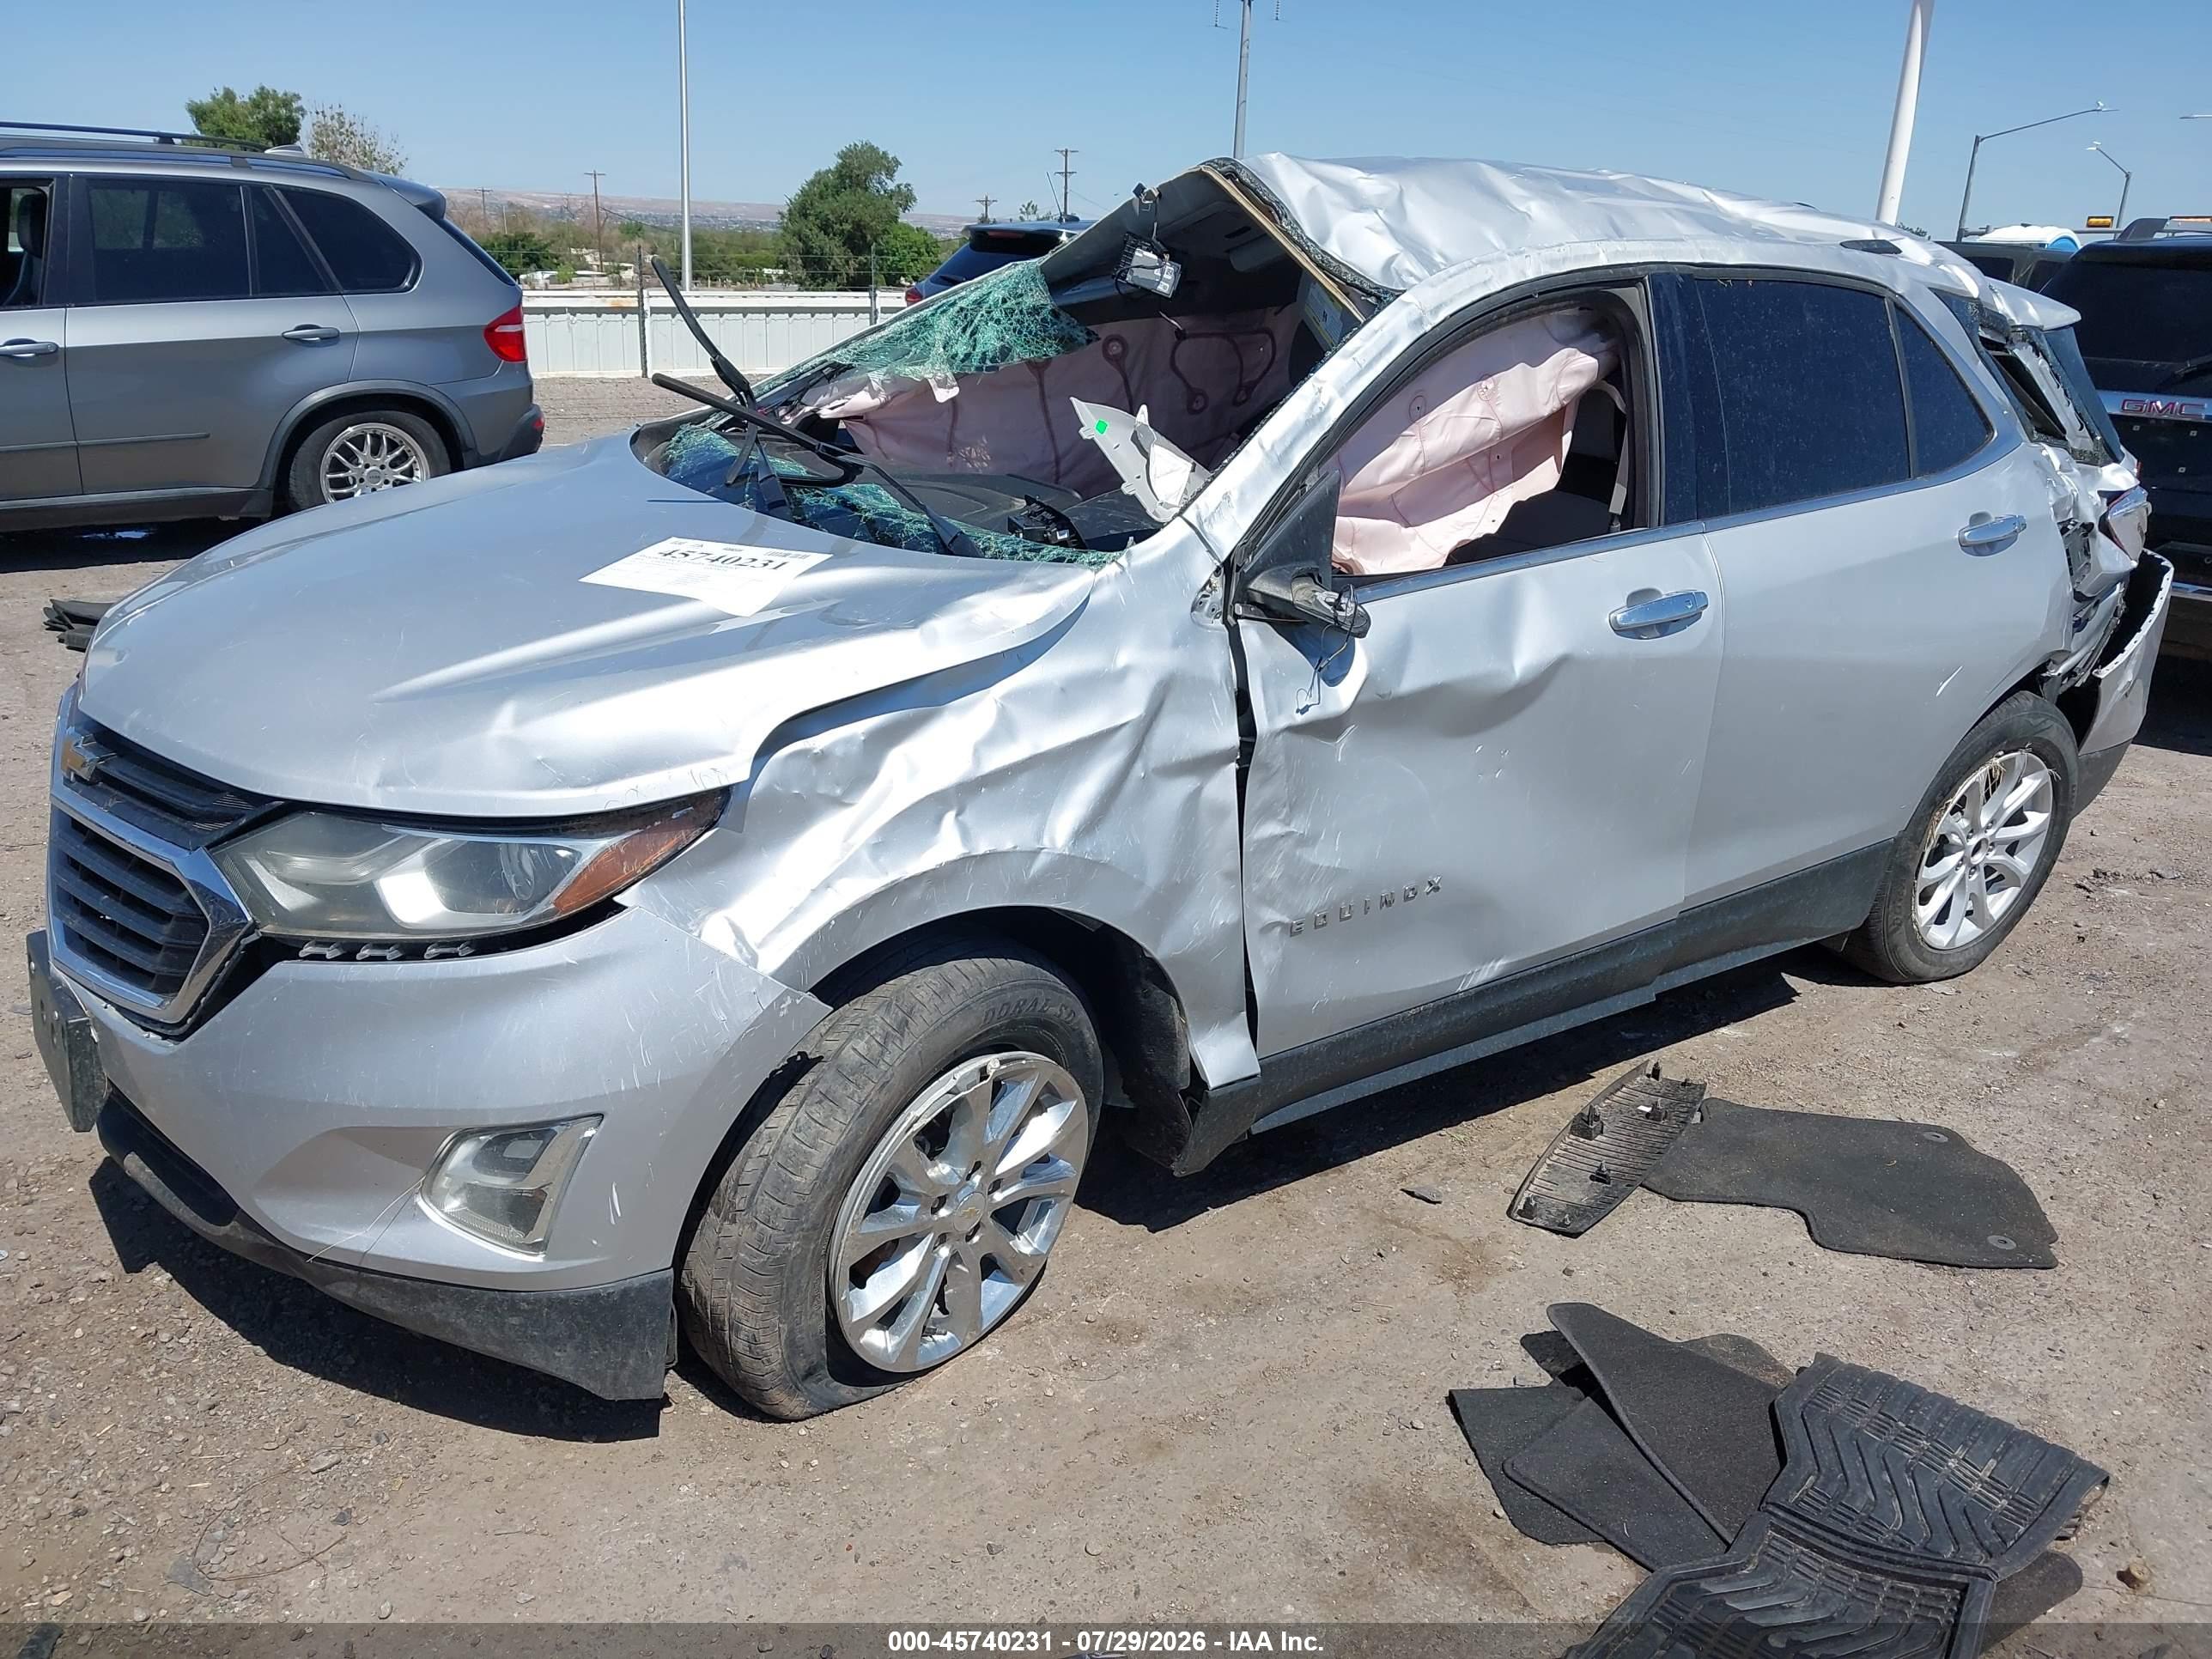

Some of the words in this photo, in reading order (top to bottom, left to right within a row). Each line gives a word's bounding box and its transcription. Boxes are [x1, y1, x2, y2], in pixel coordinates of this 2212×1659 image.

[2121, 398, 2207, 419] GMC
[659, 549, 789, 570] 45740231
[1290, 876, 1443, 937] EQUINOX
